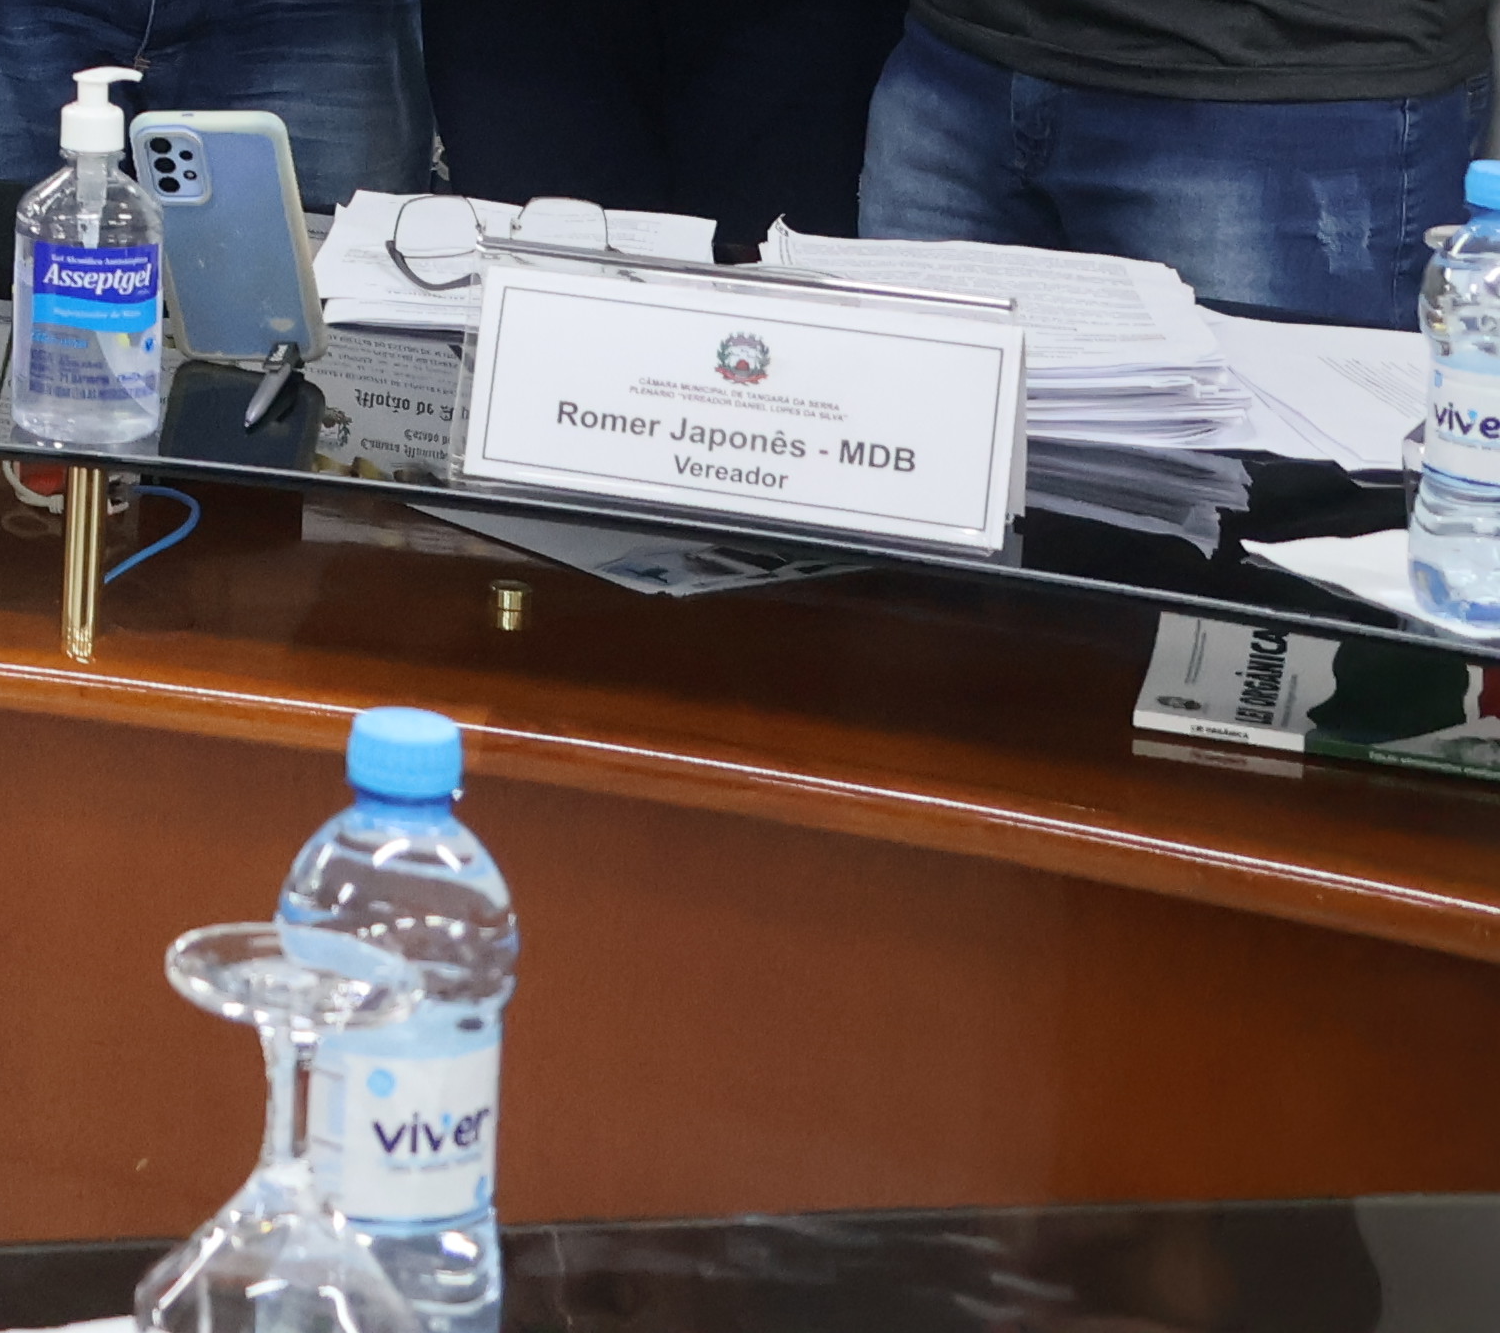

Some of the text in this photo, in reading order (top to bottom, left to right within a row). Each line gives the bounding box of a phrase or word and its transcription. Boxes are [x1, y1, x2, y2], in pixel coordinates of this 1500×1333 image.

[43, 263, 151, 295] Asseptgel
[556, 400, 661, 439] Romer
[670, 416, 807, 460] Japonês
[838, 439, 917, 473] MDB
[1435, 402, 1500, 438] vive
[676, 456, 787, 488] Vereador
[1235, 629, 1289, 708] ORGÂNICA
[374, 1111, 490, 1154] viver
